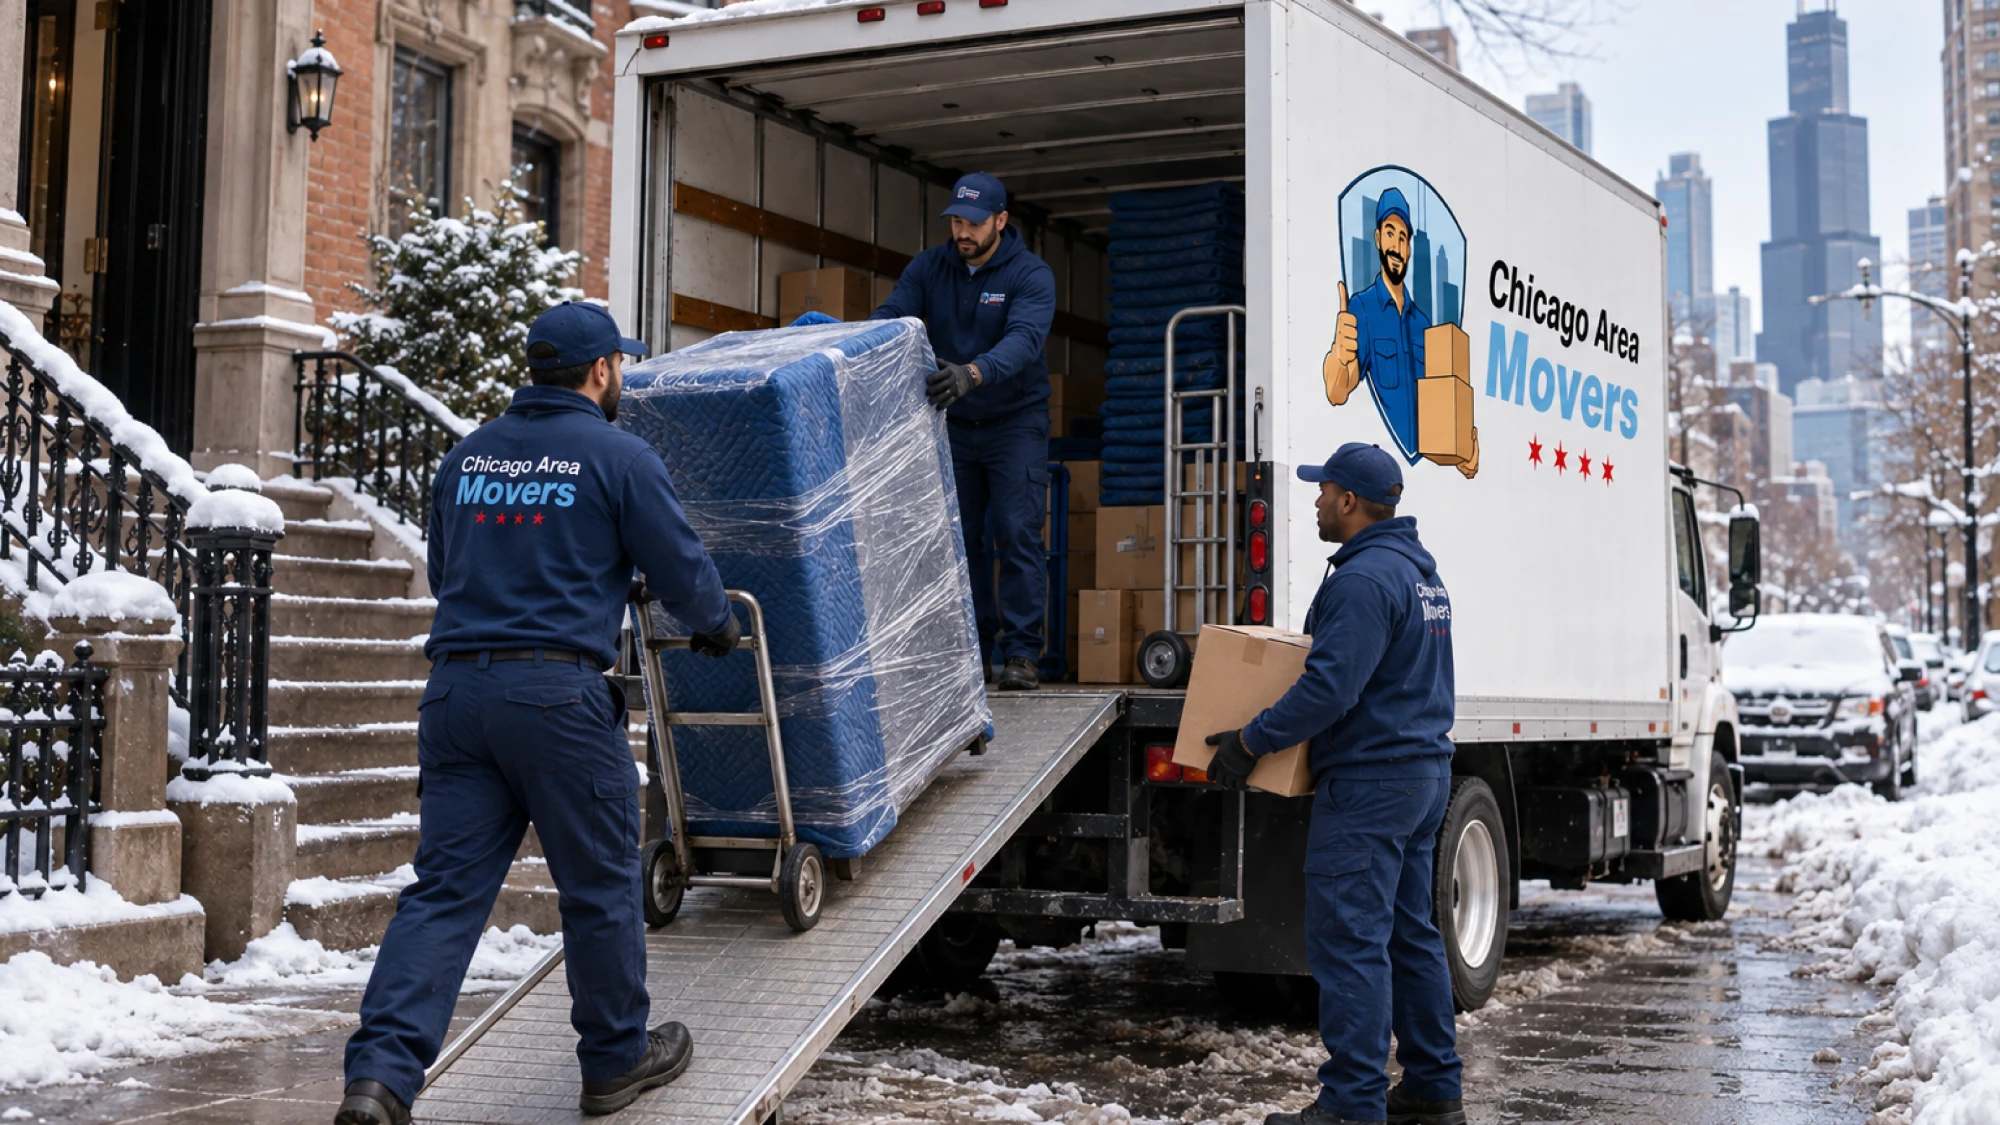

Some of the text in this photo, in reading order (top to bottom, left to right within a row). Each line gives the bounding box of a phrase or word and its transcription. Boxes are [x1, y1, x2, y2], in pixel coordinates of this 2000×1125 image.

[1489, 259, 1639, 364] Chicago Area
[1485, 320, 1639, 440] Movers
[455, 475, 577, 507] Movers
[461, 455, 581, 477] Chicago Area
